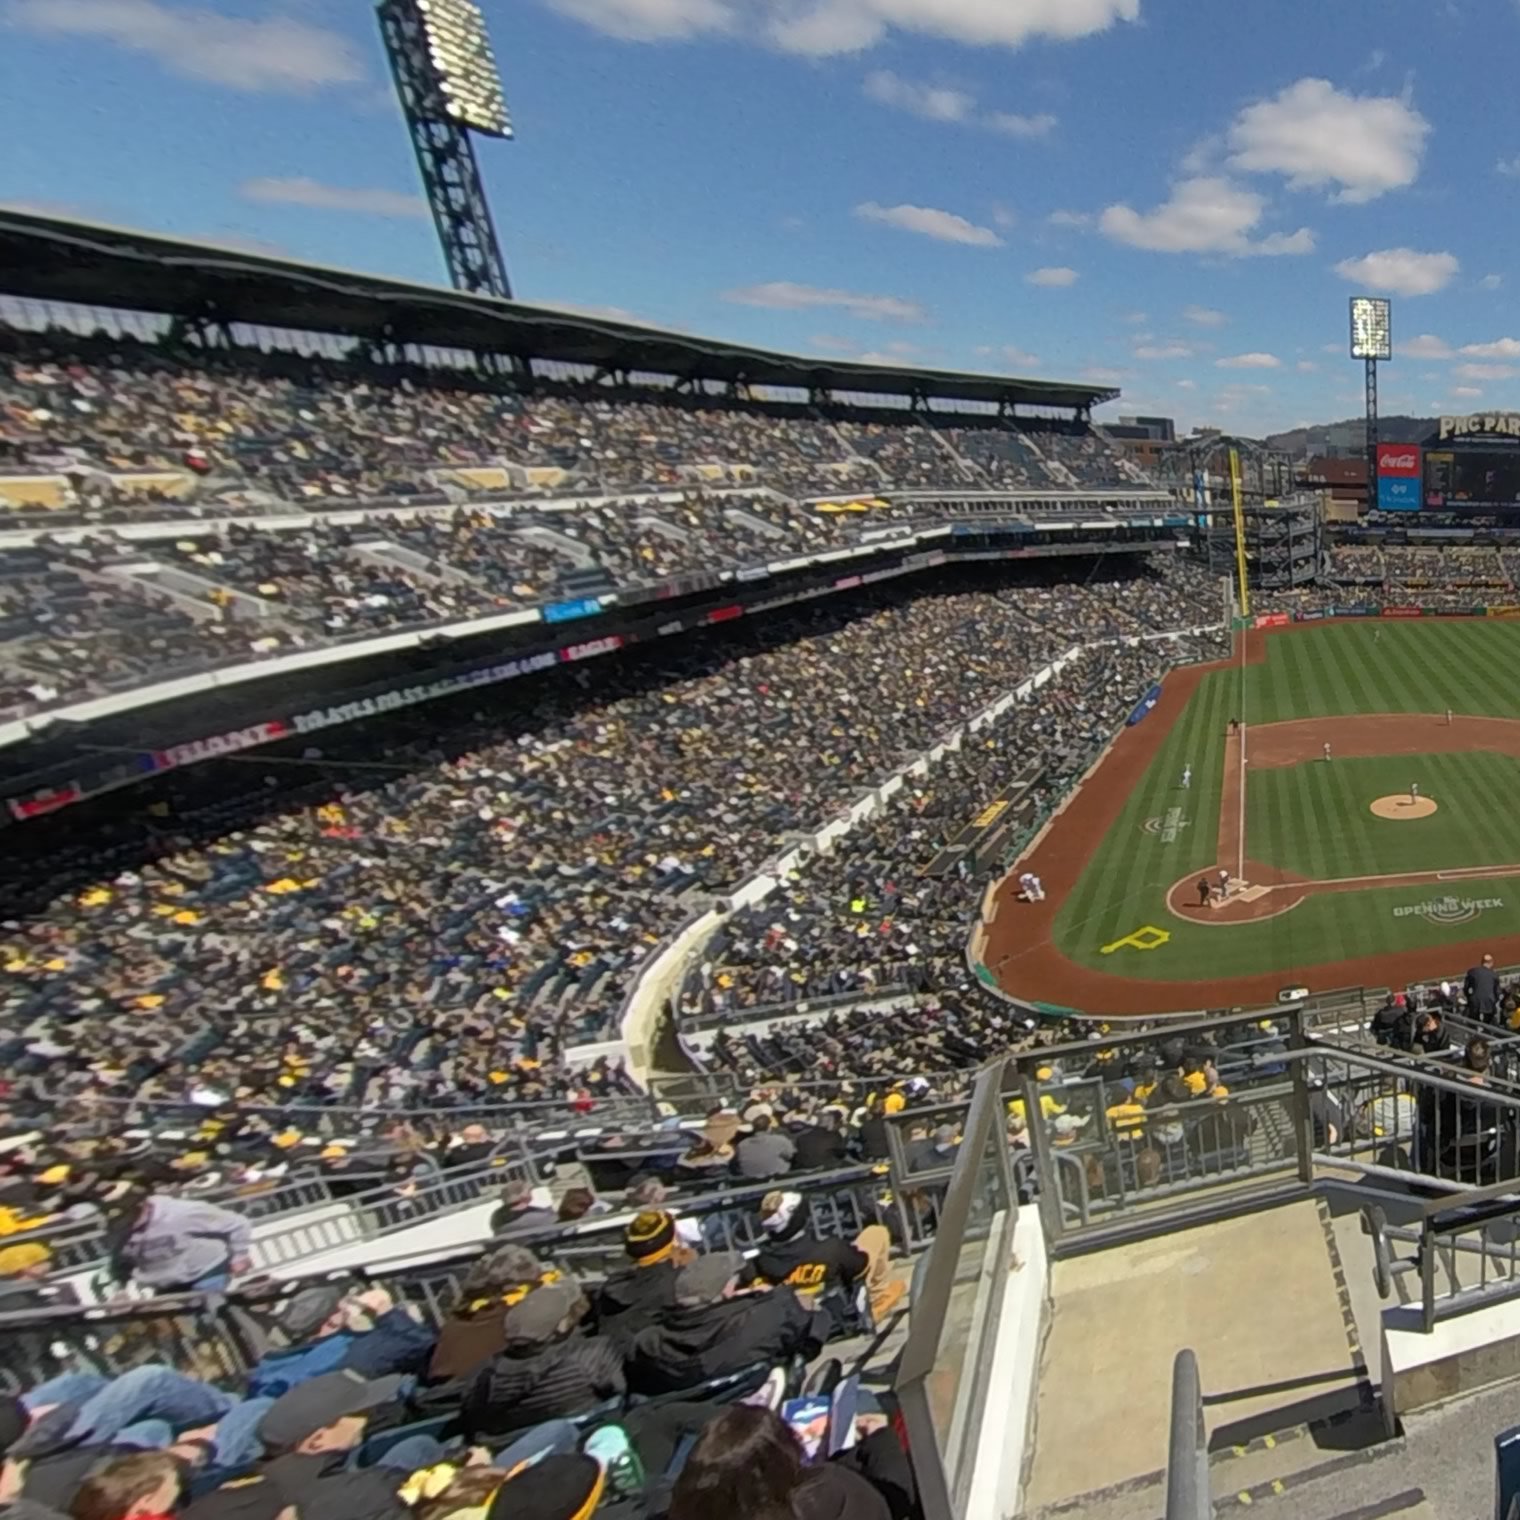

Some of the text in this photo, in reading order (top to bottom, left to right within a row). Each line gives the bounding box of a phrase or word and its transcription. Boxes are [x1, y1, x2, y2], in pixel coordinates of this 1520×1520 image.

[1439, 416, 1481, 440] PNC
[568, 636, 622, 661] EAGLE
[1393, 898, 1503, 917] OPENING WEEK
